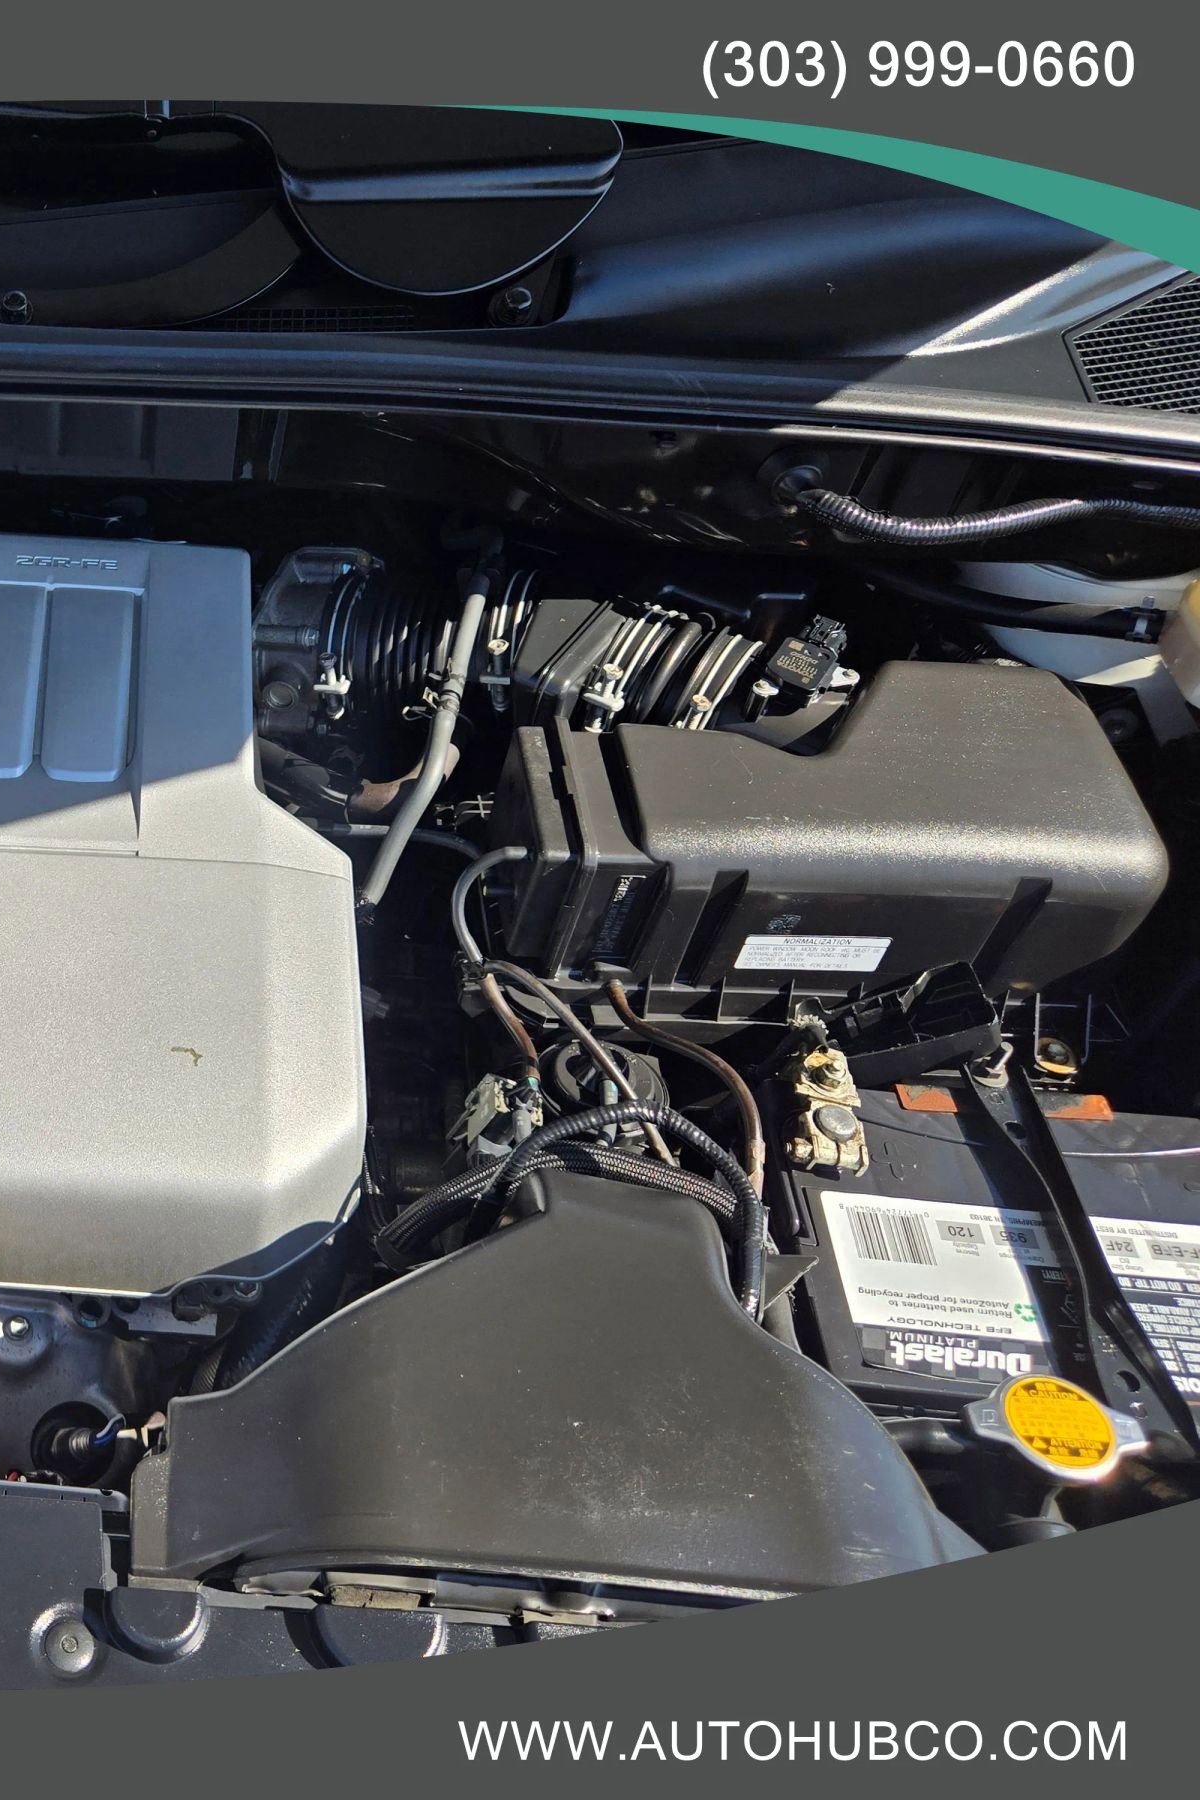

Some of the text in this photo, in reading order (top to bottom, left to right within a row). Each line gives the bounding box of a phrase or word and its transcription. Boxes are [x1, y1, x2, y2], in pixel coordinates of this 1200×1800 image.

[15, 554, 119, 570] 2GR-FE
[970, 1214, 992, 1222] 38103
[948, 1225, 975, 1238] 120
[1096, 1225, 1114, 1234] BEST
[1115, 1226, 1126, 1236] BY
[999, 1230, 1027, 1243] 935
[1105, 1239, 1133, 1253] 24F
[1151, 1243, 1200, 1258] F-EFB
[1041, 1270, 1065, 1282] TERY!
[858, 1287, 1009, 1309] AutoZone for proper recycling
[888, 1300, 1012, 1318] Return used batteries to
[886, 1316, 1012, 1334] EFB TECHNOLOGY
[890, 1341, 1031, 1376] Duralast
[1029, 1389, 1078, 1401] CAUTION
[1050, 1437, 1103, 1450] ATTENTION
